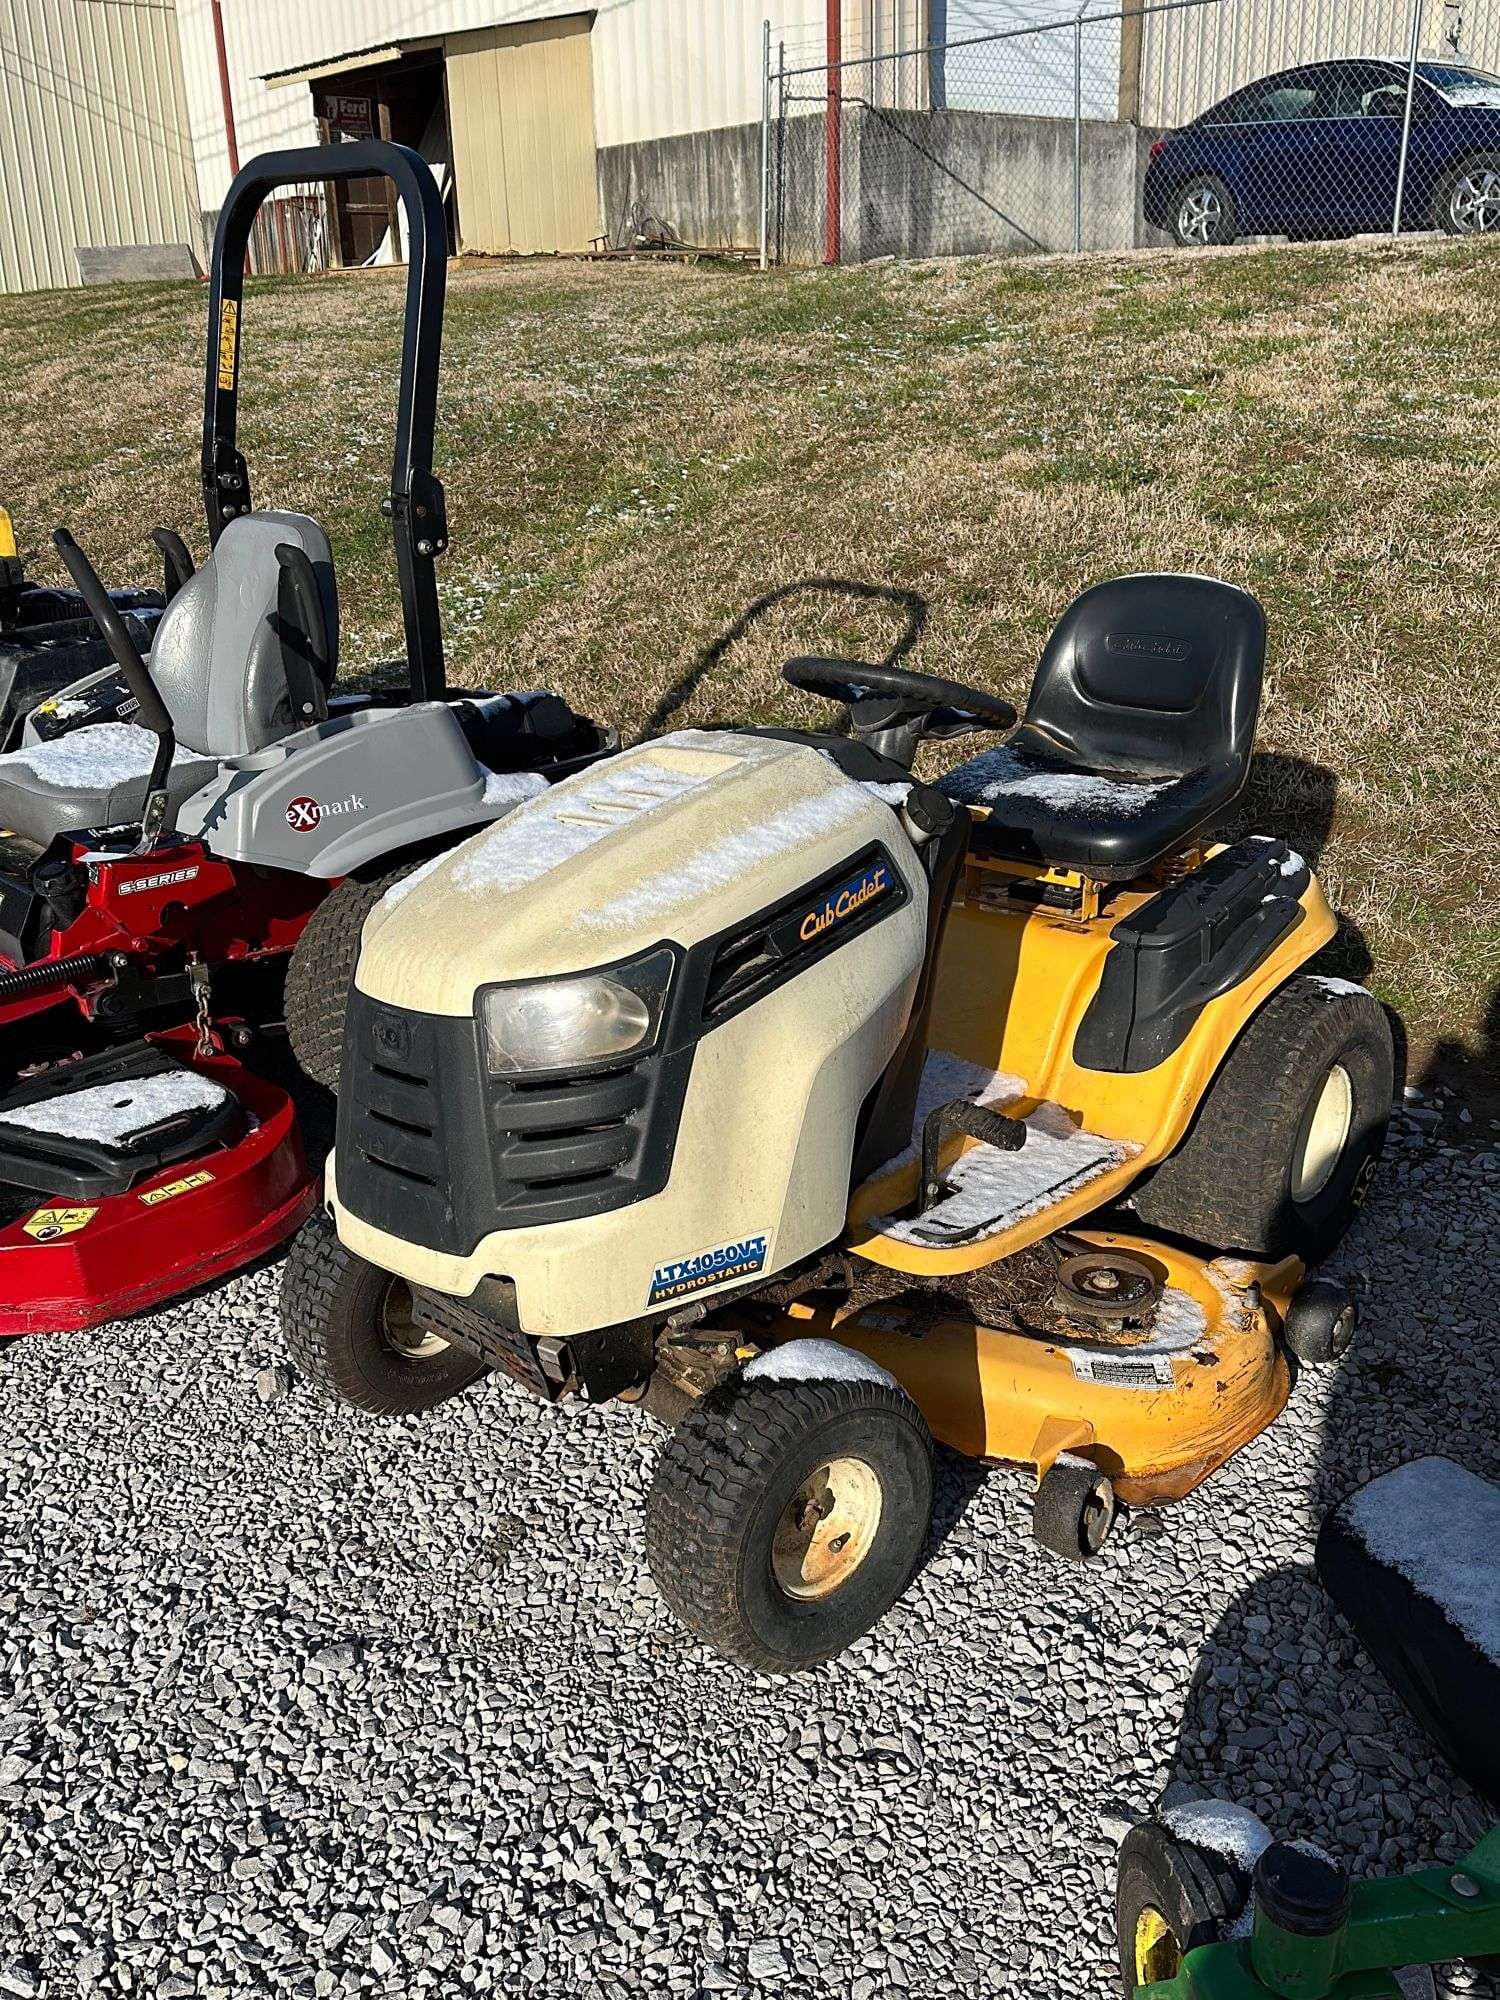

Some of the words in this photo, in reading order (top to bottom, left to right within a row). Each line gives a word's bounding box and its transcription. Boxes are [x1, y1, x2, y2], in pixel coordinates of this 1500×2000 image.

[340, 100, 367, 114] Ford
[120, 868, 197, 893] S-SERIES
[800, 902, 835, 940] Cub
[836, 868, 885, 917] Cadet
[655, 1260, 759, 1299] HYDROSTATIC
